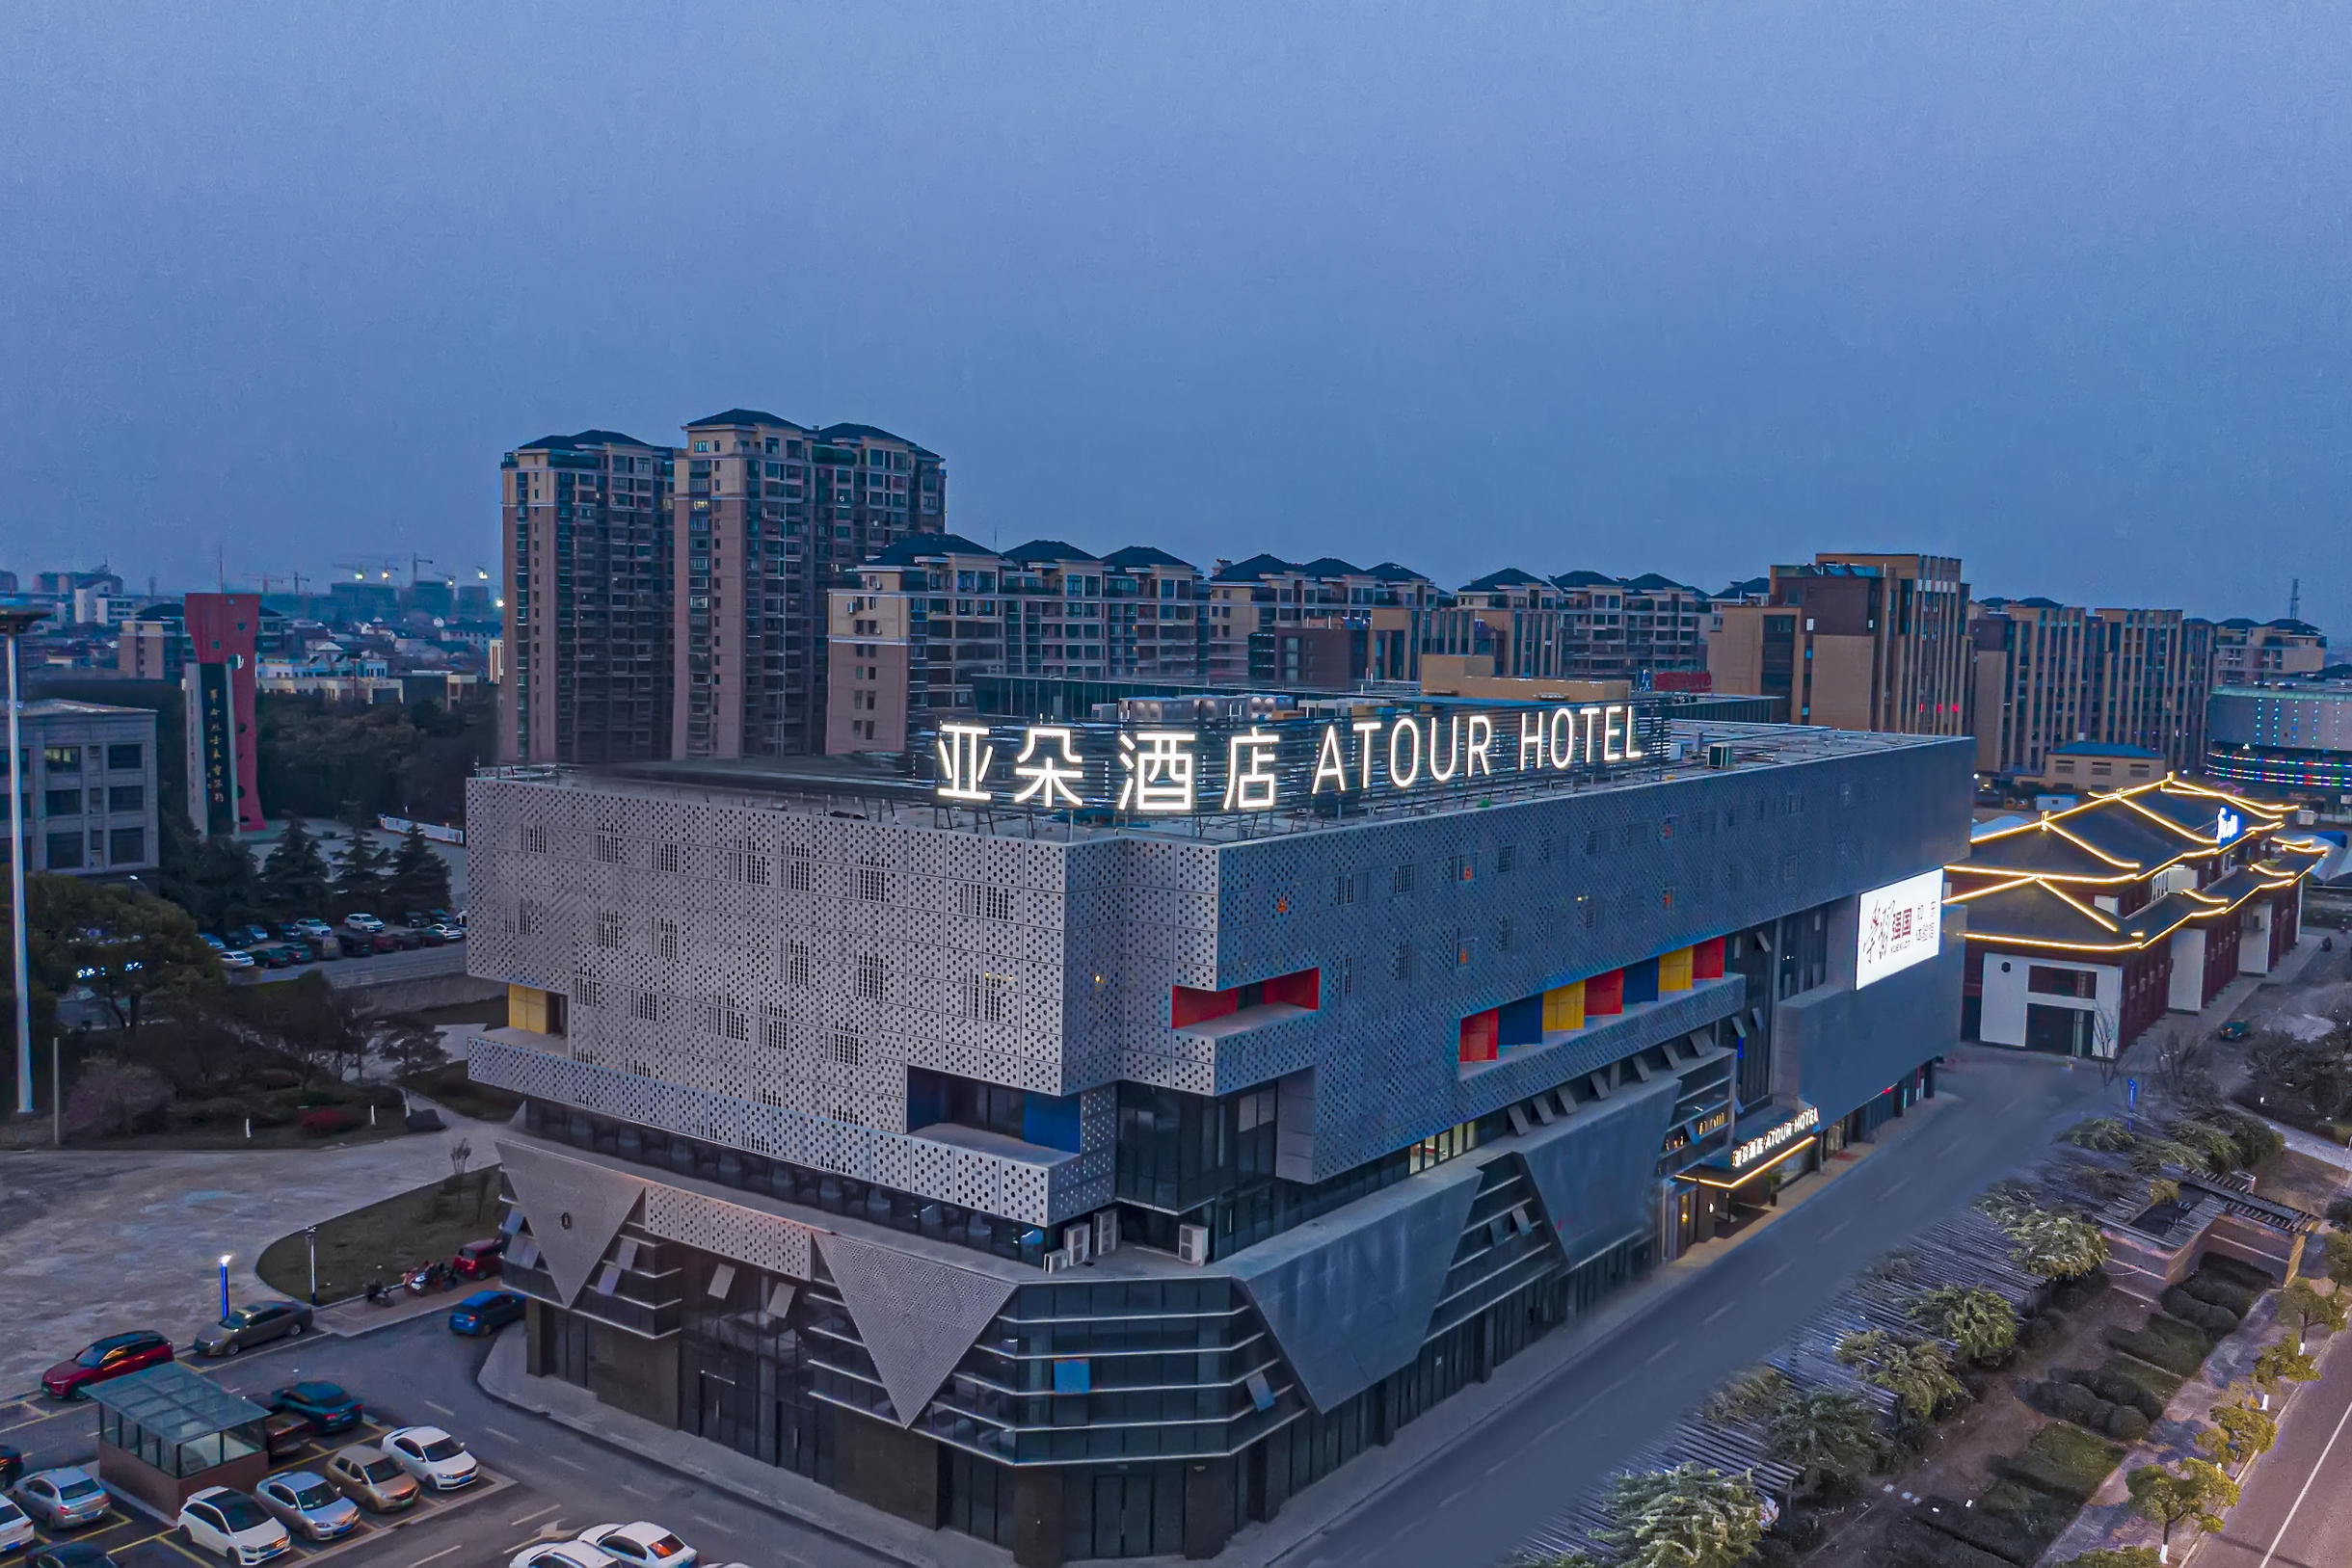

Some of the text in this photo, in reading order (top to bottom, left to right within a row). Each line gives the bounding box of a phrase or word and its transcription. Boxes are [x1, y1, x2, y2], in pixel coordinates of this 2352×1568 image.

[936, 724, 1278, 811] 亚朵酒店
[1310, 704, 1644, 795] ATOUR HOTEL
[1862, 899, 1912, 964] 学习强国
[1766, 1107, 1818, 1149] ATOUR HOTEL
